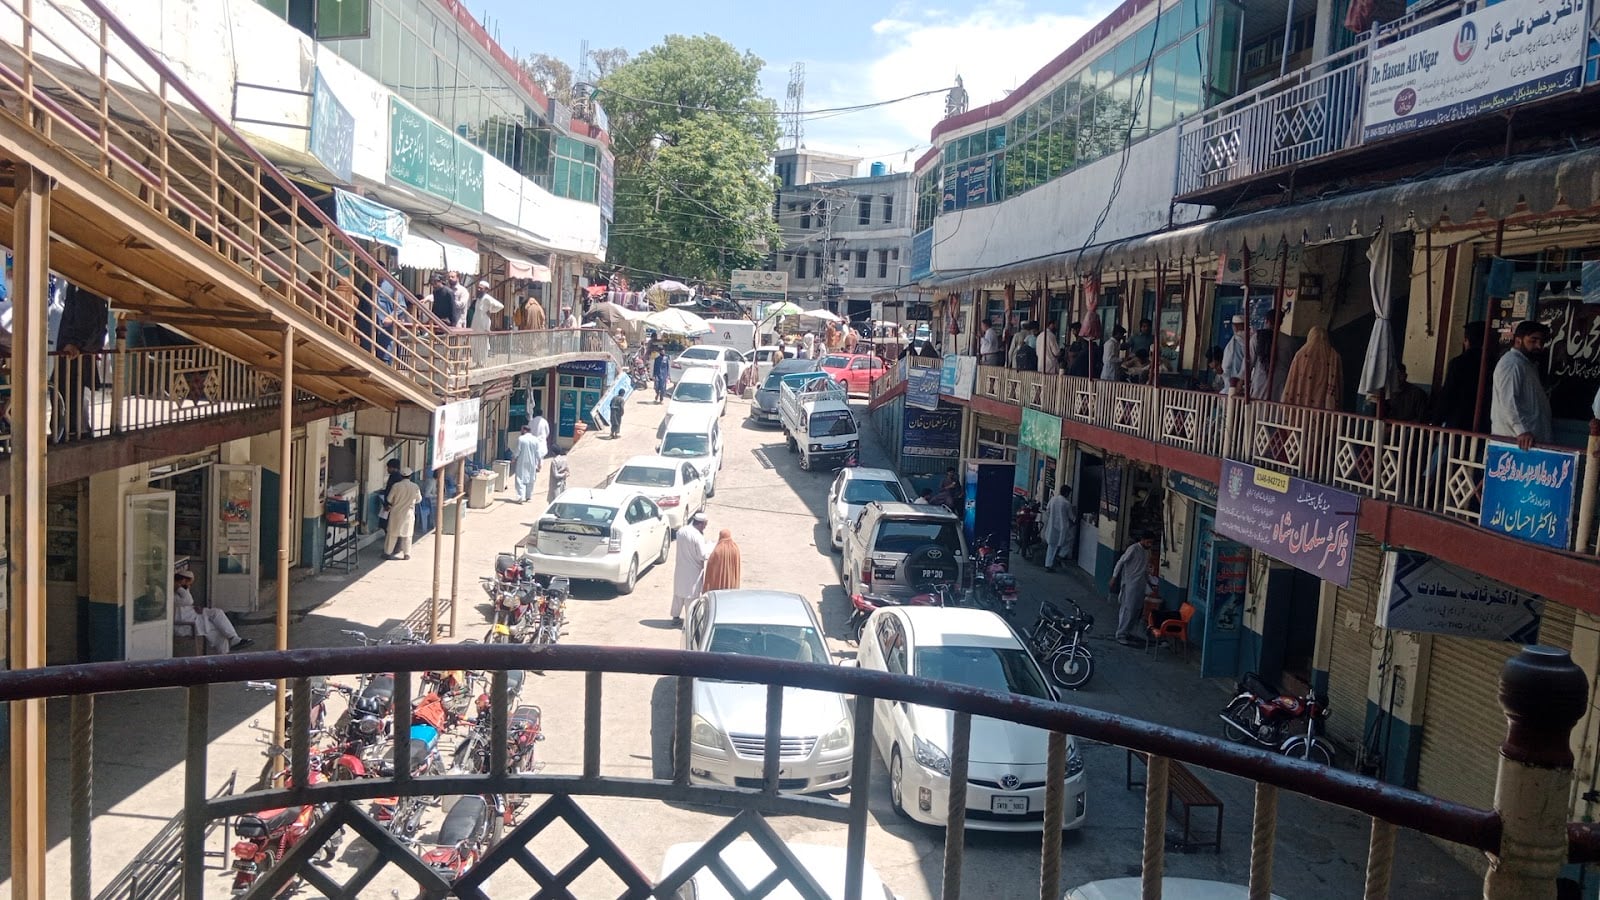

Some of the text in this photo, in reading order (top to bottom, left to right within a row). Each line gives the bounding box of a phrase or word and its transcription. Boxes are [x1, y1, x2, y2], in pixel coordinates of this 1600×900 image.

[1485, 21, 1503, 50] نگار
[1505, 18, 1525, 42] علی
[1527, 10, 1551, 35] حسن
[1371, 66, 1381, 85] Dr.
[1382, 61, 1405, 82] Hassan
[1406, 53, 1417, 74] Ali
[1418, 49, 1439, 73] Nigar
[1547, 300, 1583, 375] عالم
[908, 416, 956, 431] ڈاکٹر نعمان خان
[1273, 511, 1292, 544] شاہ
[1289, 518, 1326, 555] سلمان
[1489, 502, 1558, 539] ڈاکٹر احسان اللہ
[1318, 520, 1349, 570] ڈاکٹر
[1417, 581, 1519, 606] ڈاکٹر ثاقب سعادت
